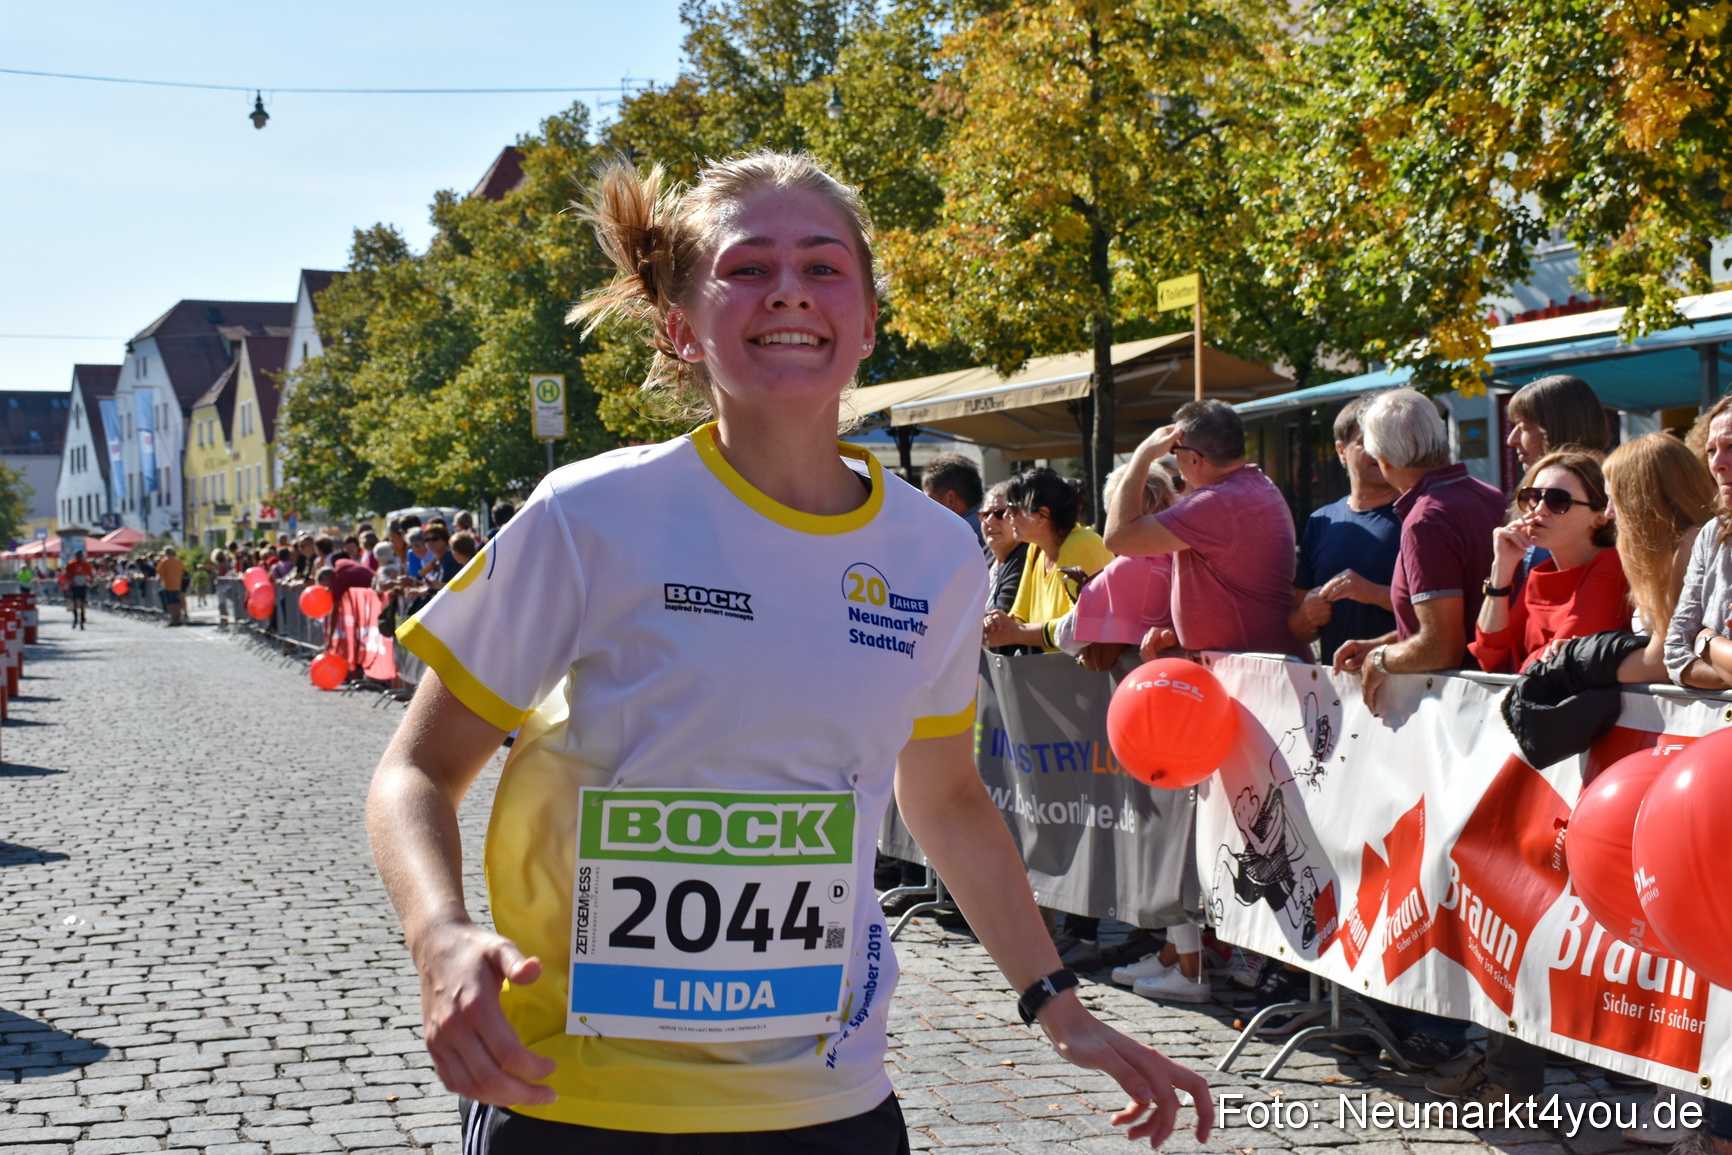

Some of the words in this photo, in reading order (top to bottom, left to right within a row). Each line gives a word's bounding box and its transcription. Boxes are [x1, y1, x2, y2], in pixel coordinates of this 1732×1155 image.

[1166, 286, 1196, 301] Toiletten
[664, 583, 753, 613] BOCK
[847, 572, 886, 606] 20
[892, 596, 926, 611] JAHRE
[724, 611, 754, 621] concepts
[849, 628, 916, 659] Stadtlauf
[1136, 672, 1204, 698] RÖDL
[601, 800, 837, 856] BOCK
[1552, 853, 1562, 872] Seit
[833, 885, 844, 898] D
[609, 875, 824, 954] 2044
[1438, 857, 1519, 971] Braun
[867, 924, 882, 962] 2019
[1549, 895, 1696, 1000] Braun
[1468, 936, 1485, 966] Sicher
[1484, 958, 1493, 975] ist
[1493, 969, 1517, 997] sicher
[653, 979, 776, 1012] LINDA
[1603, 991, 1645, 1019] Sicher
[1649, 1002, 1667, 1022] ist
[1667, 1008, 1706, 1034] sicher
